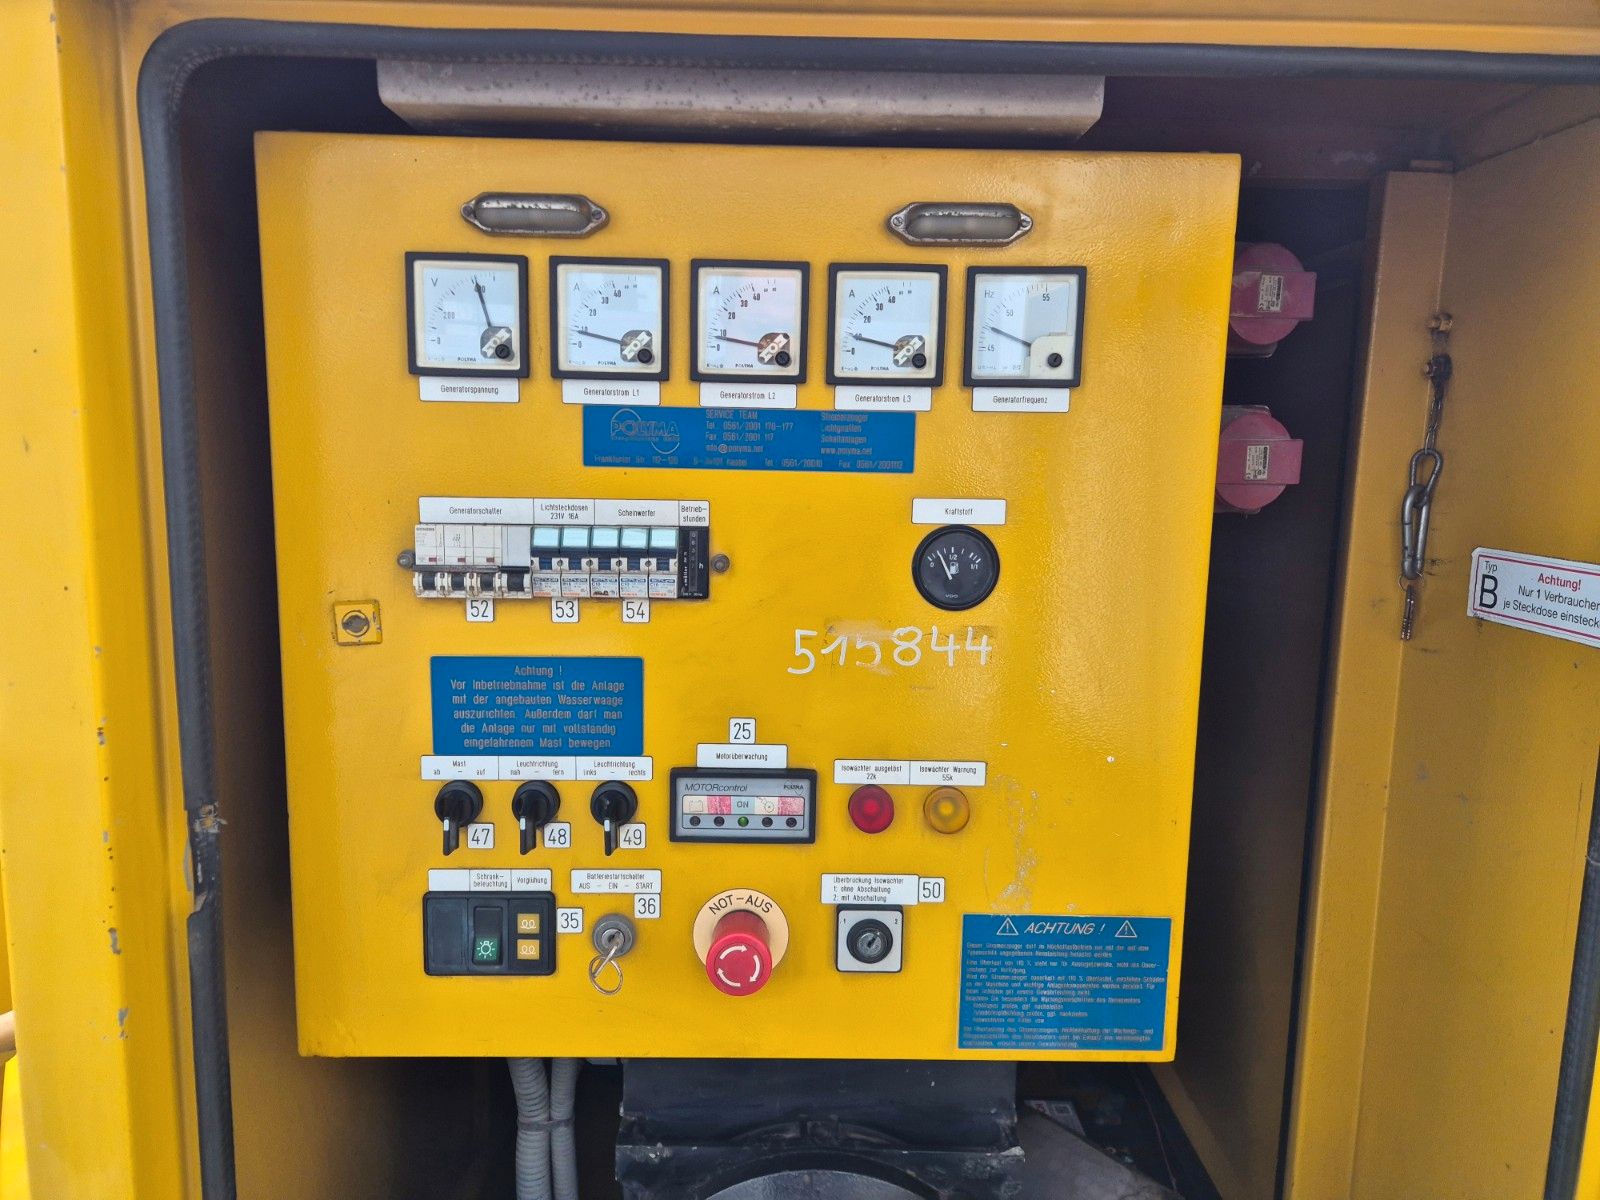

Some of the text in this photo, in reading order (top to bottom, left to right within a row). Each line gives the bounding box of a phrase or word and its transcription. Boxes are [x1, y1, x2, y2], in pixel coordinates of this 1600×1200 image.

[431, 277, 438, 287] V
[574, 283, 580, 291] A
[614, 289, 621, 298] 40
[713, 285, 720, 295] A
[849, 289, 855, 298] A
[984, 289, 995, 298] Hz
[753, 292, 760, 301] 40
[1042, 293, 1050, 301] 55
[740, 299, 748, 307] 30
[875, 303, 883, 311] 30
[589, 309, 597, 317] 20
[1006, 309, 1014, 317] 50
[863, 315, 871, 323] 20
[720, 329, 727, 337] 10
[987, 344, 995, 352] 45
[440, 384, 499, 395] Generatorspannung
[583, 387, 640, 398] Generatorstrom L1
[720, 391, 776, 400] Generatorstrom L2
[855, 394, 911, 403] Generatorstrom L3
[993, 395, 1048, 404] Generatorfrequenz
[706, 410, 758, 420] SERVICE TEAM
[611, 419, 680, 437] POLYMA
[706, 432, 717, 441] Fax
[449, 507, 502, 515] Generatorschalter
[618, 509, 655, 517] Scheinwerfer
[945, 508, 973, 516] Kraftstoff
[1485, 561, 1497, 573] Typ
[1538, 573, 1581, 592] Achtung!
[1479, 574, 1498, 608] B
[1519, 585, 1533, 597] Nur
[1537, 589, 1541, 599] 1
[470, 599, 489, 617] 52
[556, 599, 575, 618] 53
[626, 601, 645, 619] 54
[1503, 599, 1600, 628] je Steckdose einsteck
[515, 665, 553, 677] Achtung
[451, 680, 624, 693] Vor Inbetriebnahme ist die Anlage
[452, 695, 466, 704] mit
[473, 695, 488, 704] der
[496, 695, 551, 706] angebauten
[525, 709, 571, 719] Außerdem
[578, 710, 597, 719] darf
[604, 711, 622, 719] man
[461, 724, 475, 733] die
[482, 724, 514, 735] Anlage
[521, 725, 535, 733] nur
[543, 724, 556, 733] mit
[734, 722, 751, 740] 25
[464, 738, 610, 750] eingefahrenem Mast bewegen
[716, 753, 767, 761] Motorüberwachung
[875, 765, 902, 773] ausgelöst
[953, 766, 976, 774] Warnung
[471, 828, 490, 845] 47
[548, 828, 566, 845] 48
[623, 828, 642, 845] 49
[474, 880, 508, 888] beleuchtung
[517, 877, 547, 885] Vorglühung
[858, 886, 891, 894] Abschaltung
[923, 881, 941, 899] 50
[853, 894, 886, 903] Abschaltung
[638, 898, 655, 914] 36
[708, 894, 773, 915] NOT-AUS
[560, 912, 579, 929] 35
[1024, 922, 1095, 935] ACHTUNG
